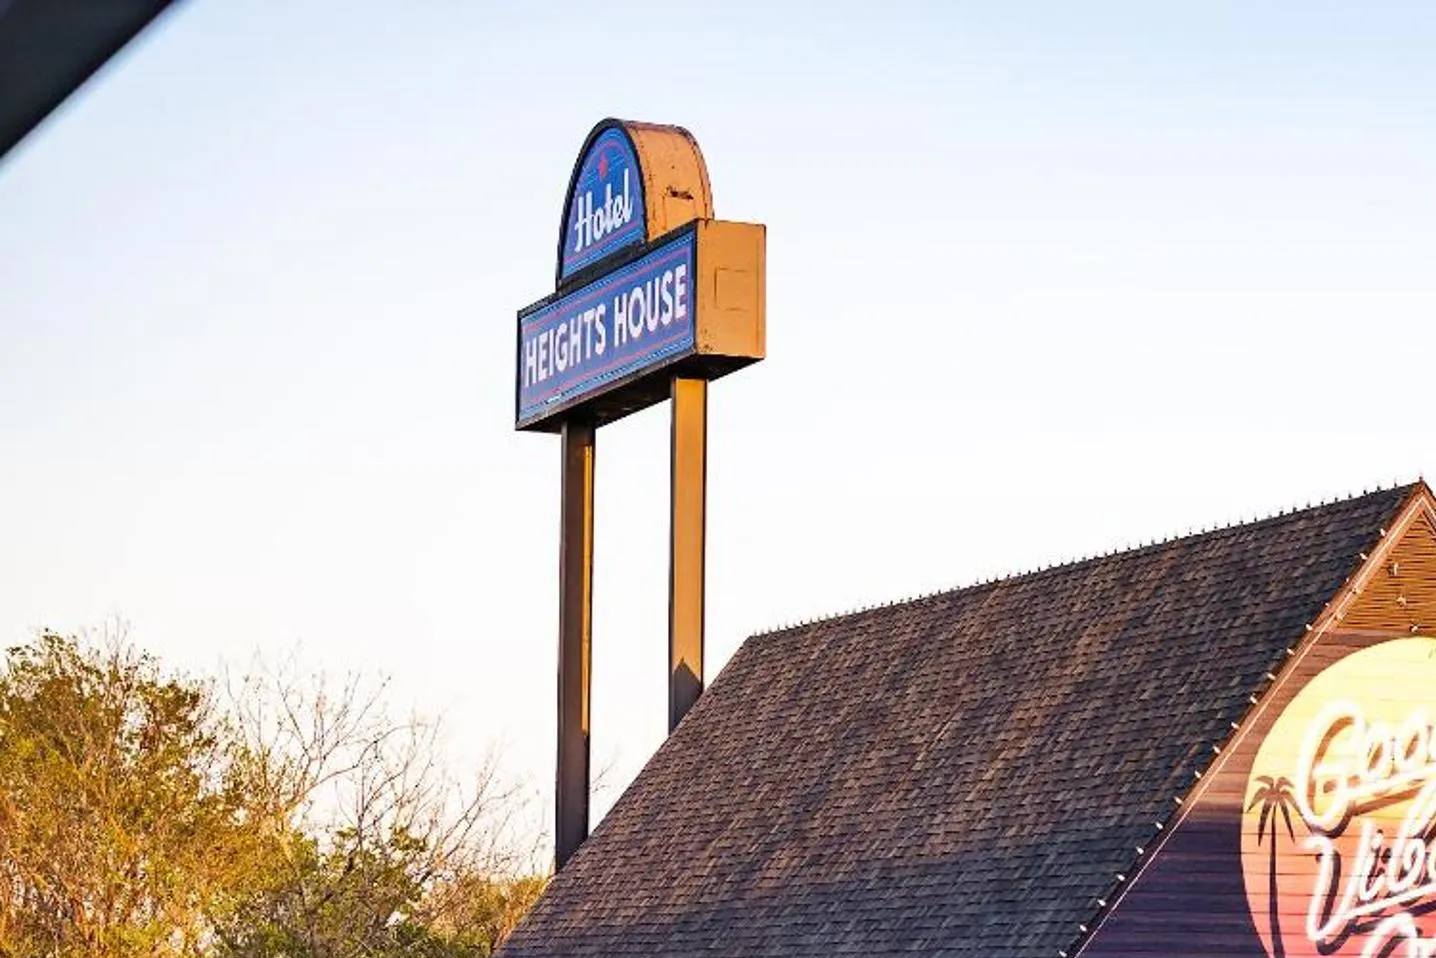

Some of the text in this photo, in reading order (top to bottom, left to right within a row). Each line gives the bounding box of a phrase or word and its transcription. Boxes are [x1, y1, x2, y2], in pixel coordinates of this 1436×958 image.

[574, 168, 633, 253] Hotel
[523, 263, 687, 388] HEIGHTS HOUSE
